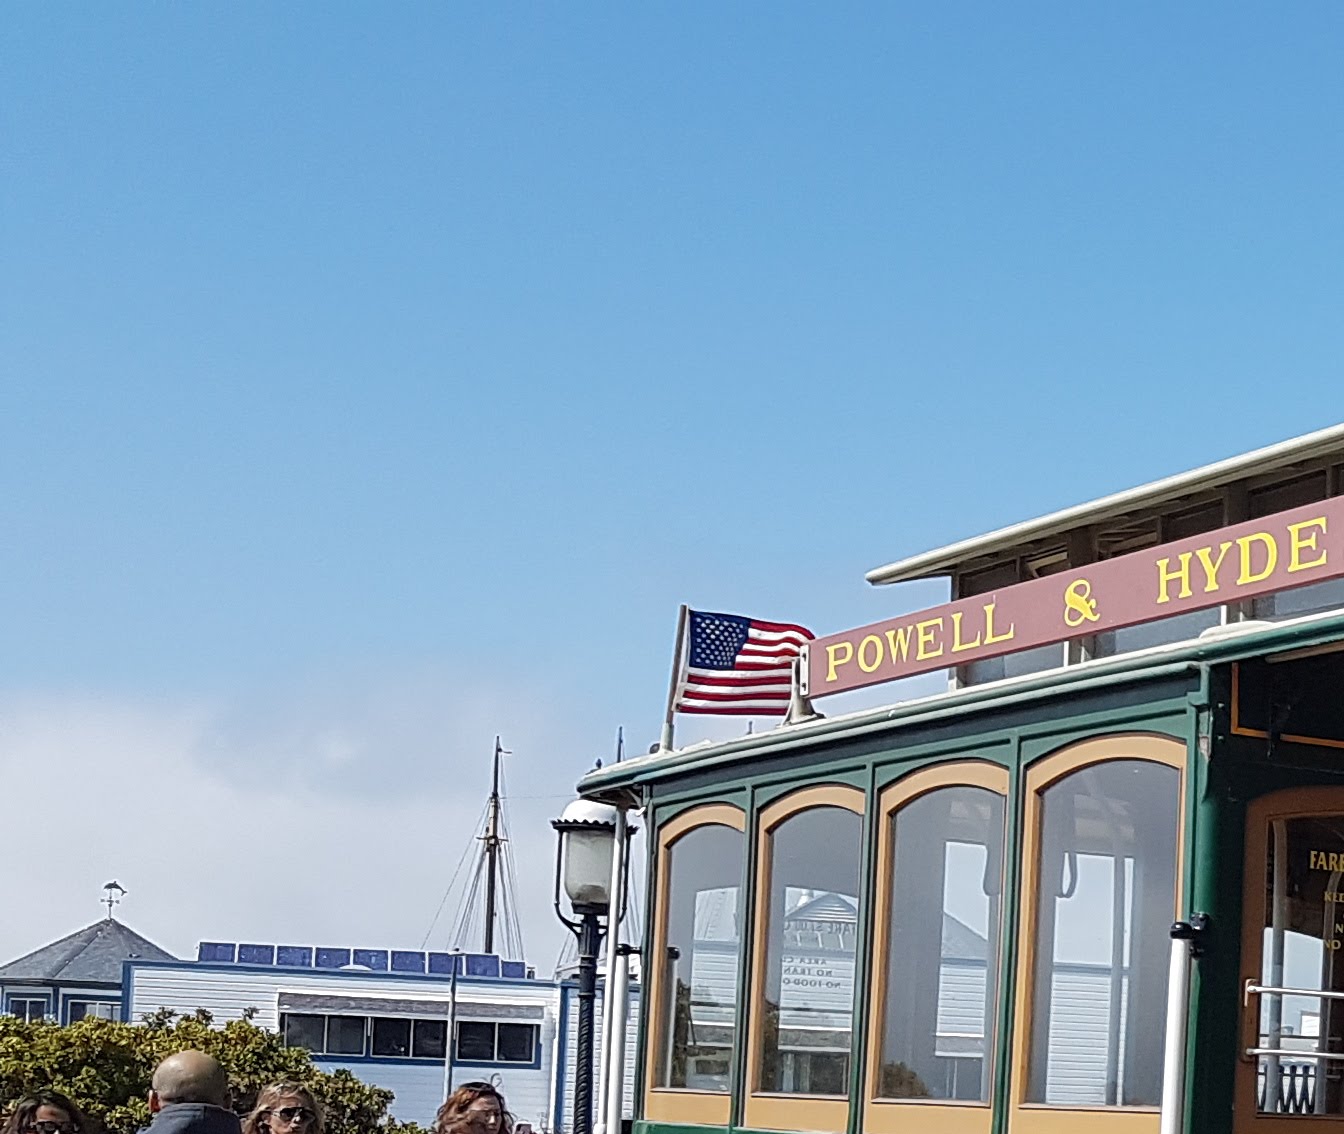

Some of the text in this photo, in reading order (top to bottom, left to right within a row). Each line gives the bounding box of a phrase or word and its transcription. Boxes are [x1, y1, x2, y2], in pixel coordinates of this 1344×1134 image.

[825, 603, 1015, 683] POWELL
[1063, 579, 1101, 628] &
[1156, 516, 1328, 604] HYDE
[1325, 939, 1342, 950] NO
